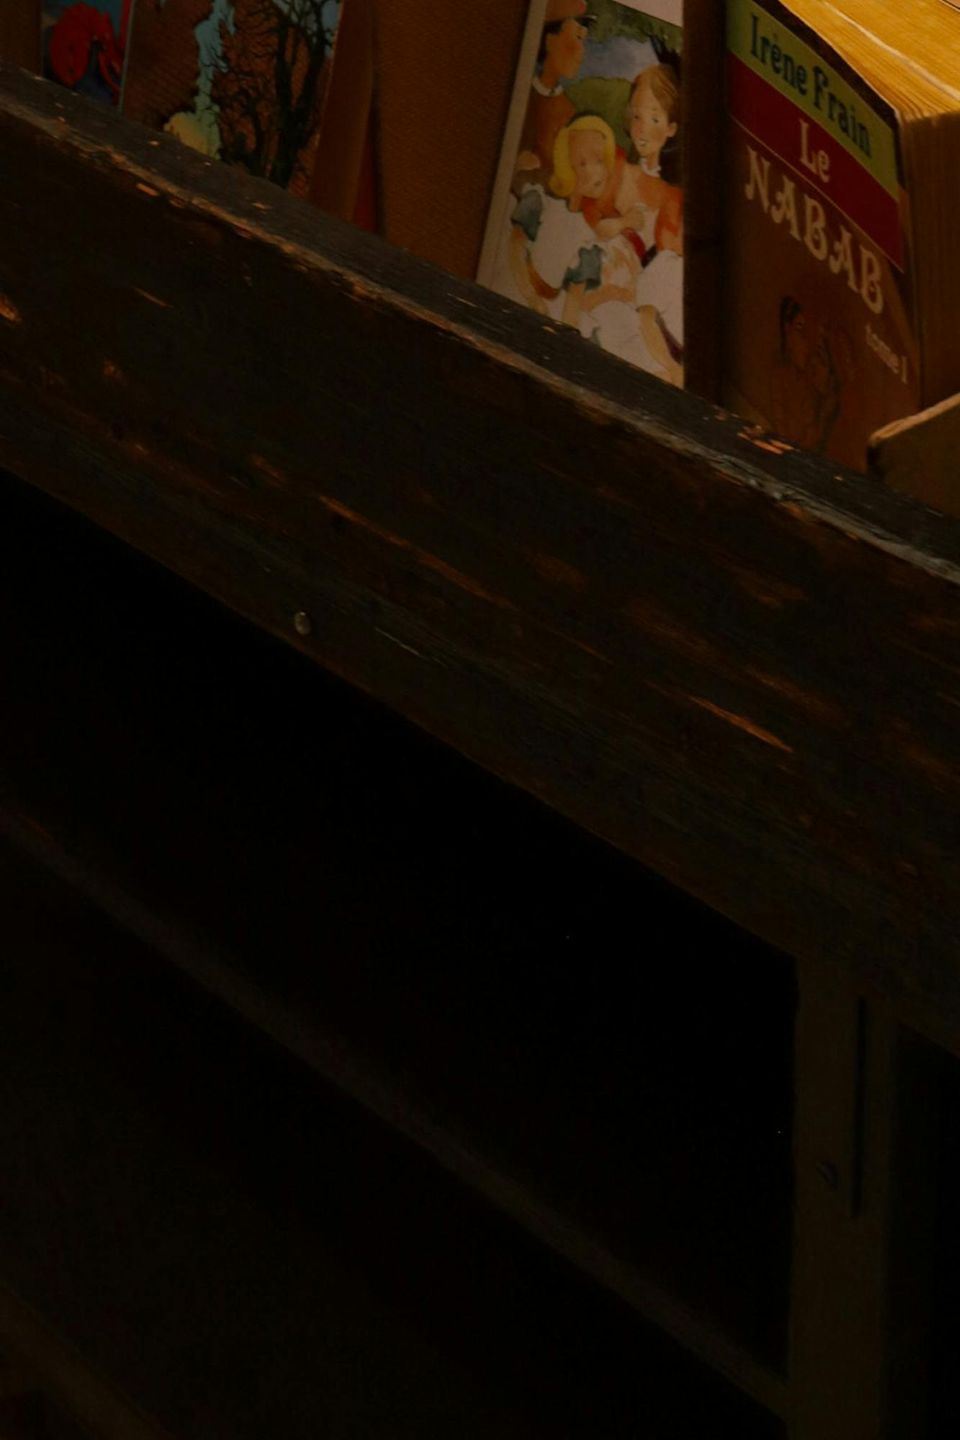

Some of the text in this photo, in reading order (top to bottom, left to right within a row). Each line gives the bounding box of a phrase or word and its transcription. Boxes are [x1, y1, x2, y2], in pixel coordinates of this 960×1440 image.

[799, 117, 832, 184] Le
[812, 64, 873, 159] Frain
[744, 144, 885, 315] NABAB
